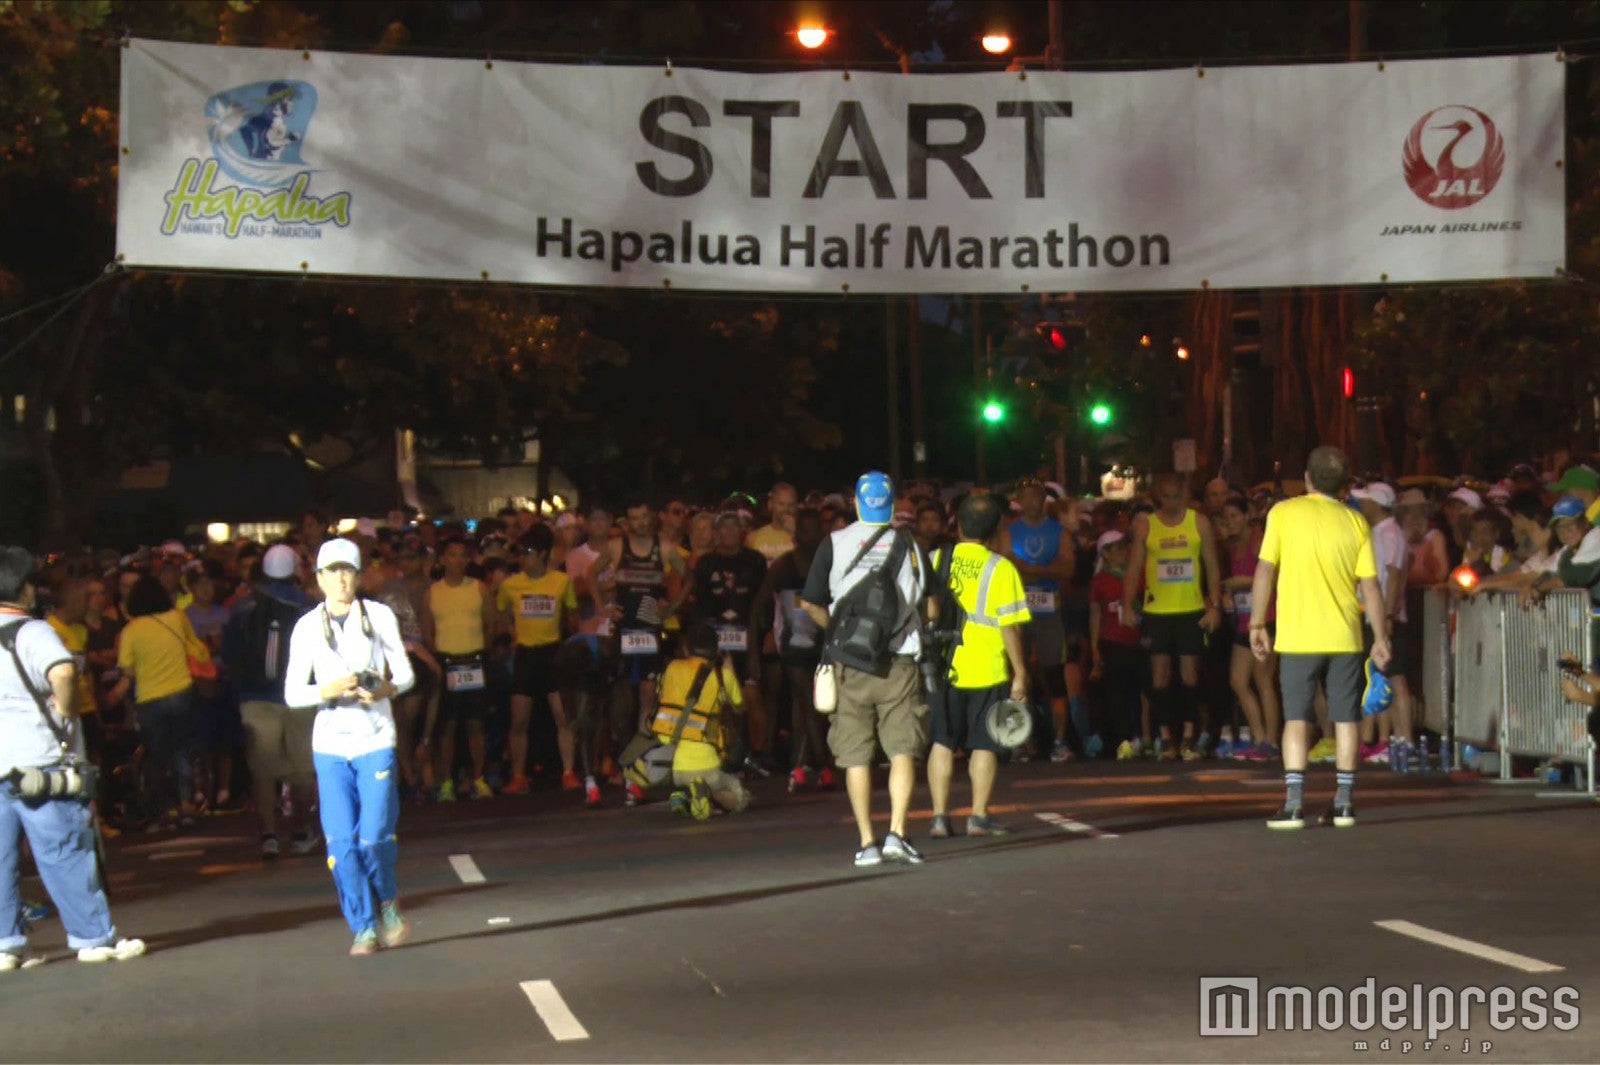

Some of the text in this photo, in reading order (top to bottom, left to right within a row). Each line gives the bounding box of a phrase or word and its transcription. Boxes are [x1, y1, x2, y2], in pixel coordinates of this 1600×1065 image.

[635, 95, 1073, 200] START
[160, 158, 351, 239] Hapalua
[1428, 178, 1486, 198] JAL
[535, 216, 1171, 272] Hapalua Half Marathon
[1380, 221, 1523, 236] JAPAN AIRLINES
